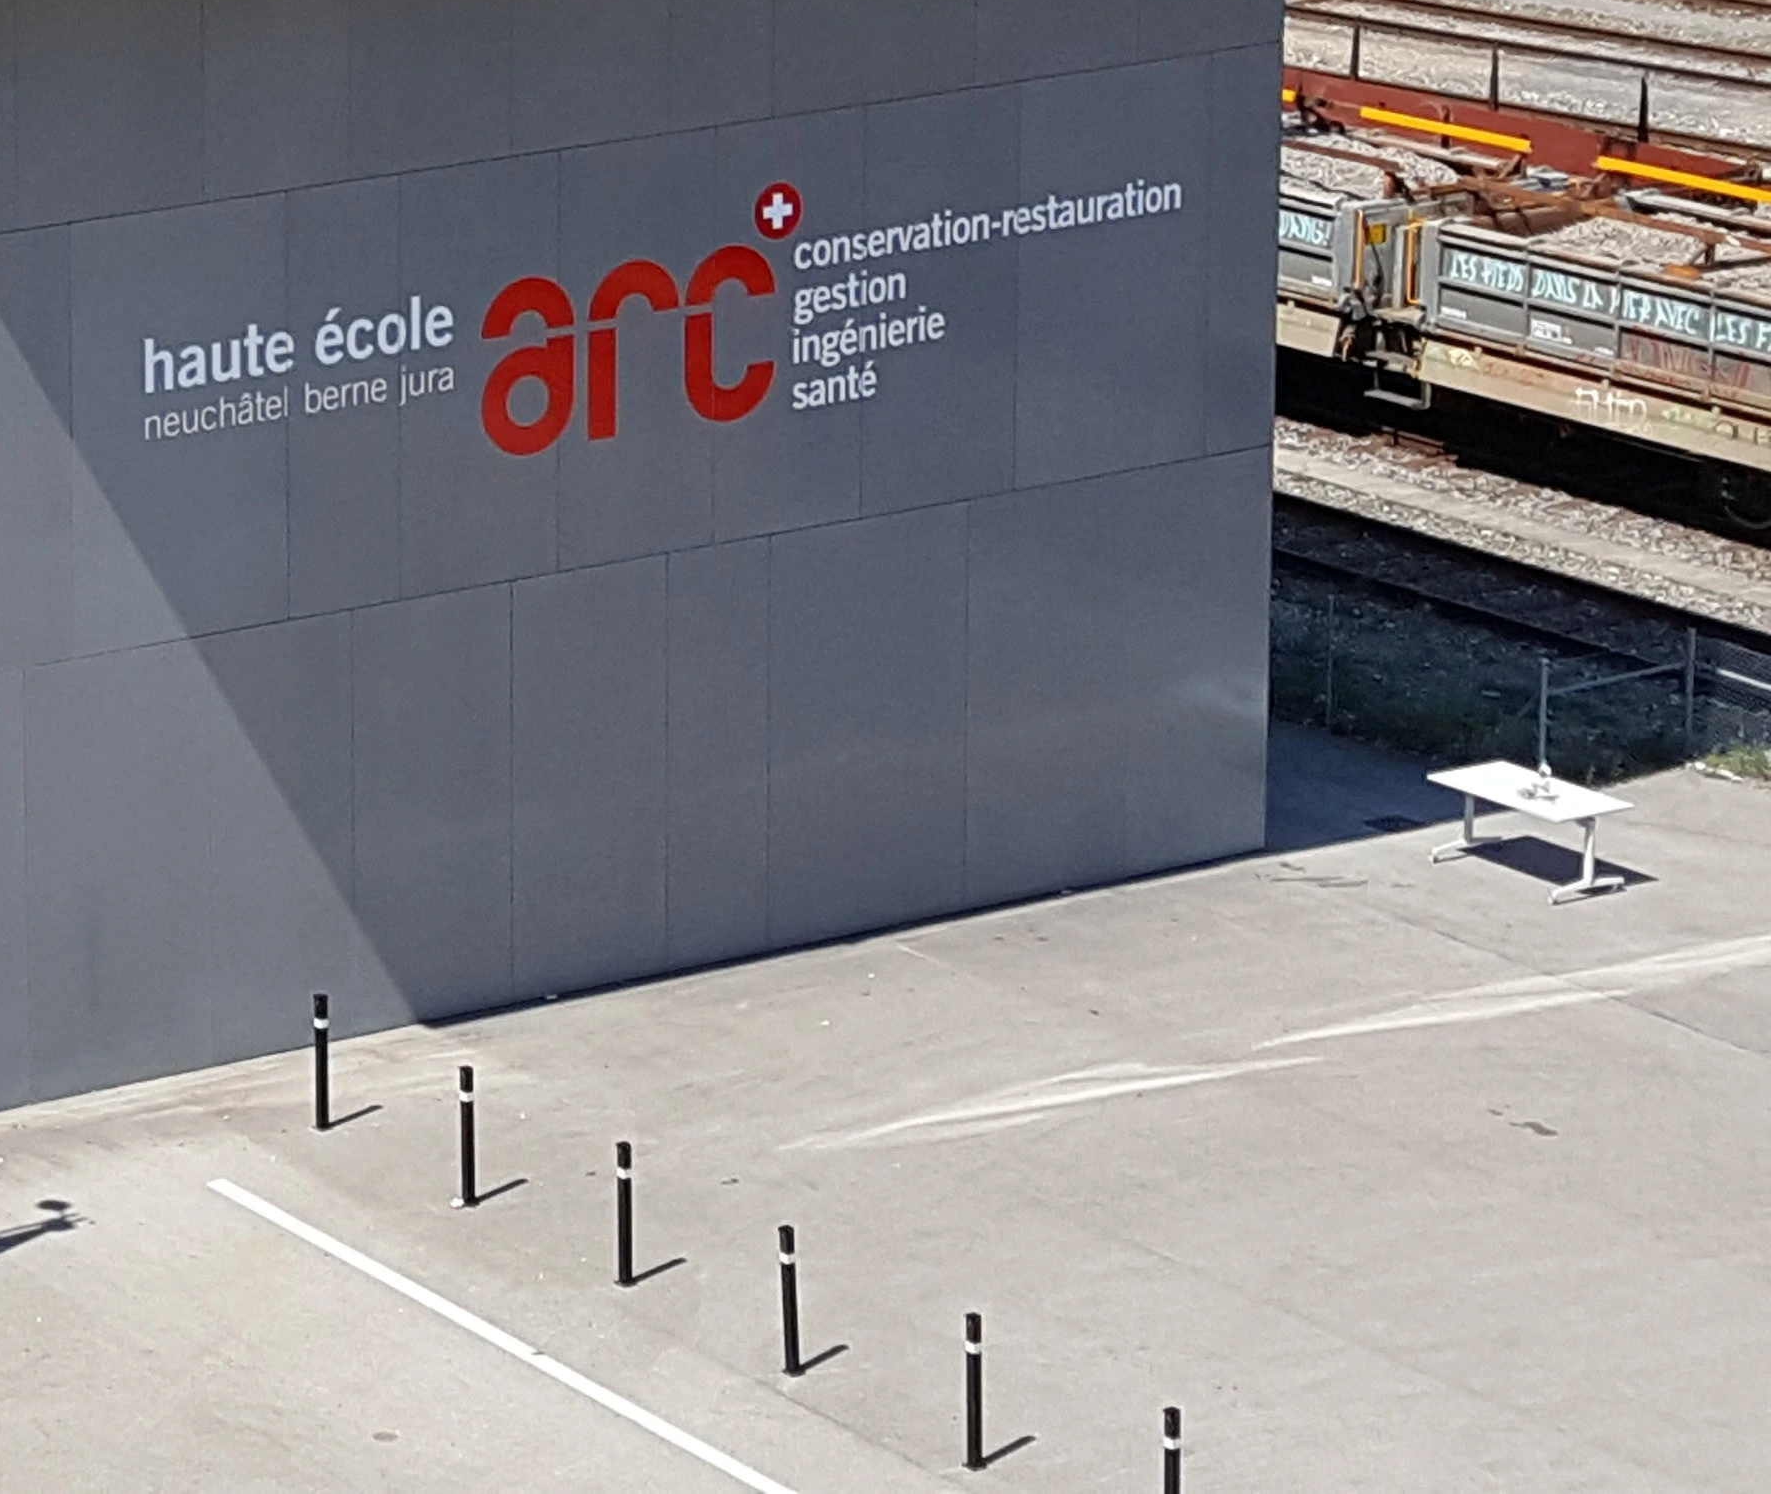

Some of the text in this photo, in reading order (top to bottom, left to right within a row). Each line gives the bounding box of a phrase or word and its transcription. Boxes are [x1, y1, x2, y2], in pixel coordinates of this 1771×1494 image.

[793, 179, 1182, 270] conservation-restauration
[793, 269, 907, 325] gestion
[144, 296, 454, 393] haute école
[480, 244, 776, 456] arc
[792, 305, 945, 368] ingénierie
[144, 365, 455, 439] neuchâtel berne jura
[792, 361, 877, 410] santé
